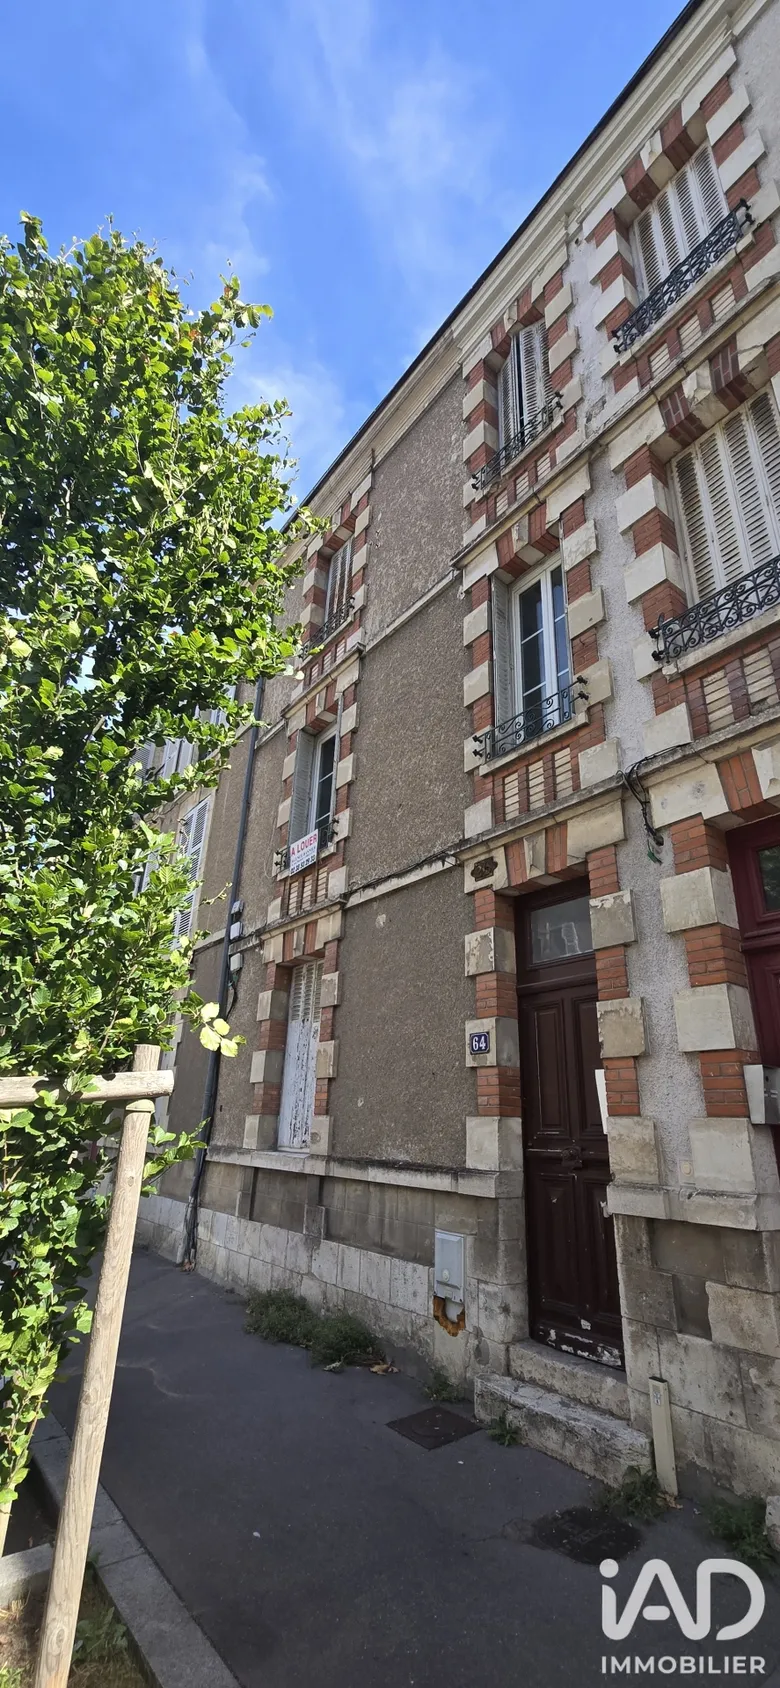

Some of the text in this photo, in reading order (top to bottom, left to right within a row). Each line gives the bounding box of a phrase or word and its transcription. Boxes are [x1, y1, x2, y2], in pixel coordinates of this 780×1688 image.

[291, 847, 296, 856] A
[297, 833, 317, 853] LOUER
[473, 1036, 486, 1050] 64
